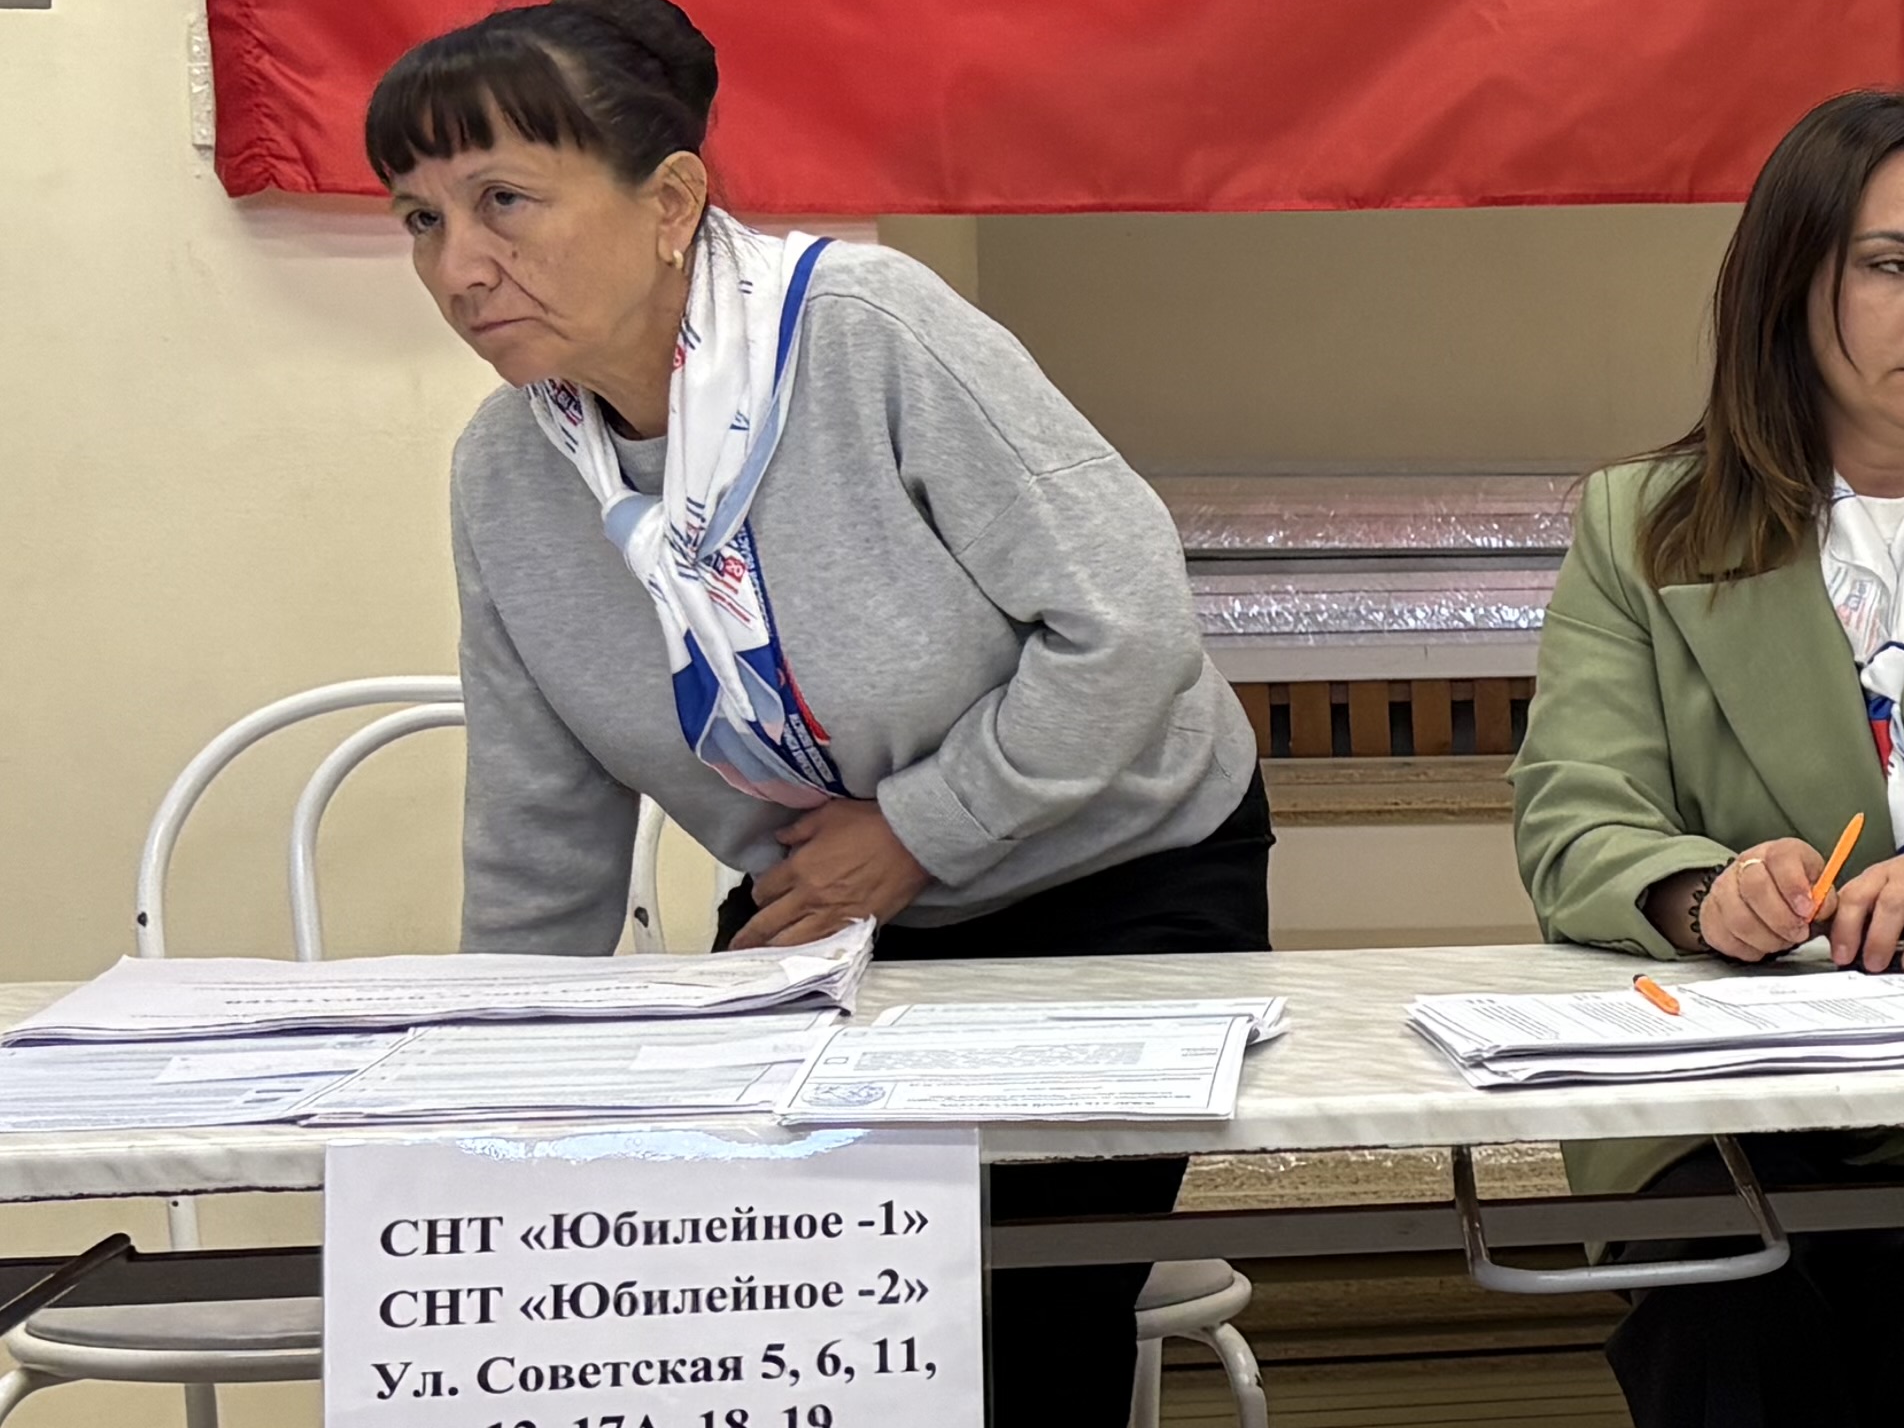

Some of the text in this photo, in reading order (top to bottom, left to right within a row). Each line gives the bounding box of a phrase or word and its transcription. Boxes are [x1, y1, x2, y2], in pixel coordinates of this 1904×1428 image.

[379, 1199, 929, 1257] СНТ «Юбилейное -1»
[379, 1268, 929, 1329] СНТ «Юбилейное -2»
[371, 1336, 937, 1400] Ул. Советская 5, 6, 11,
